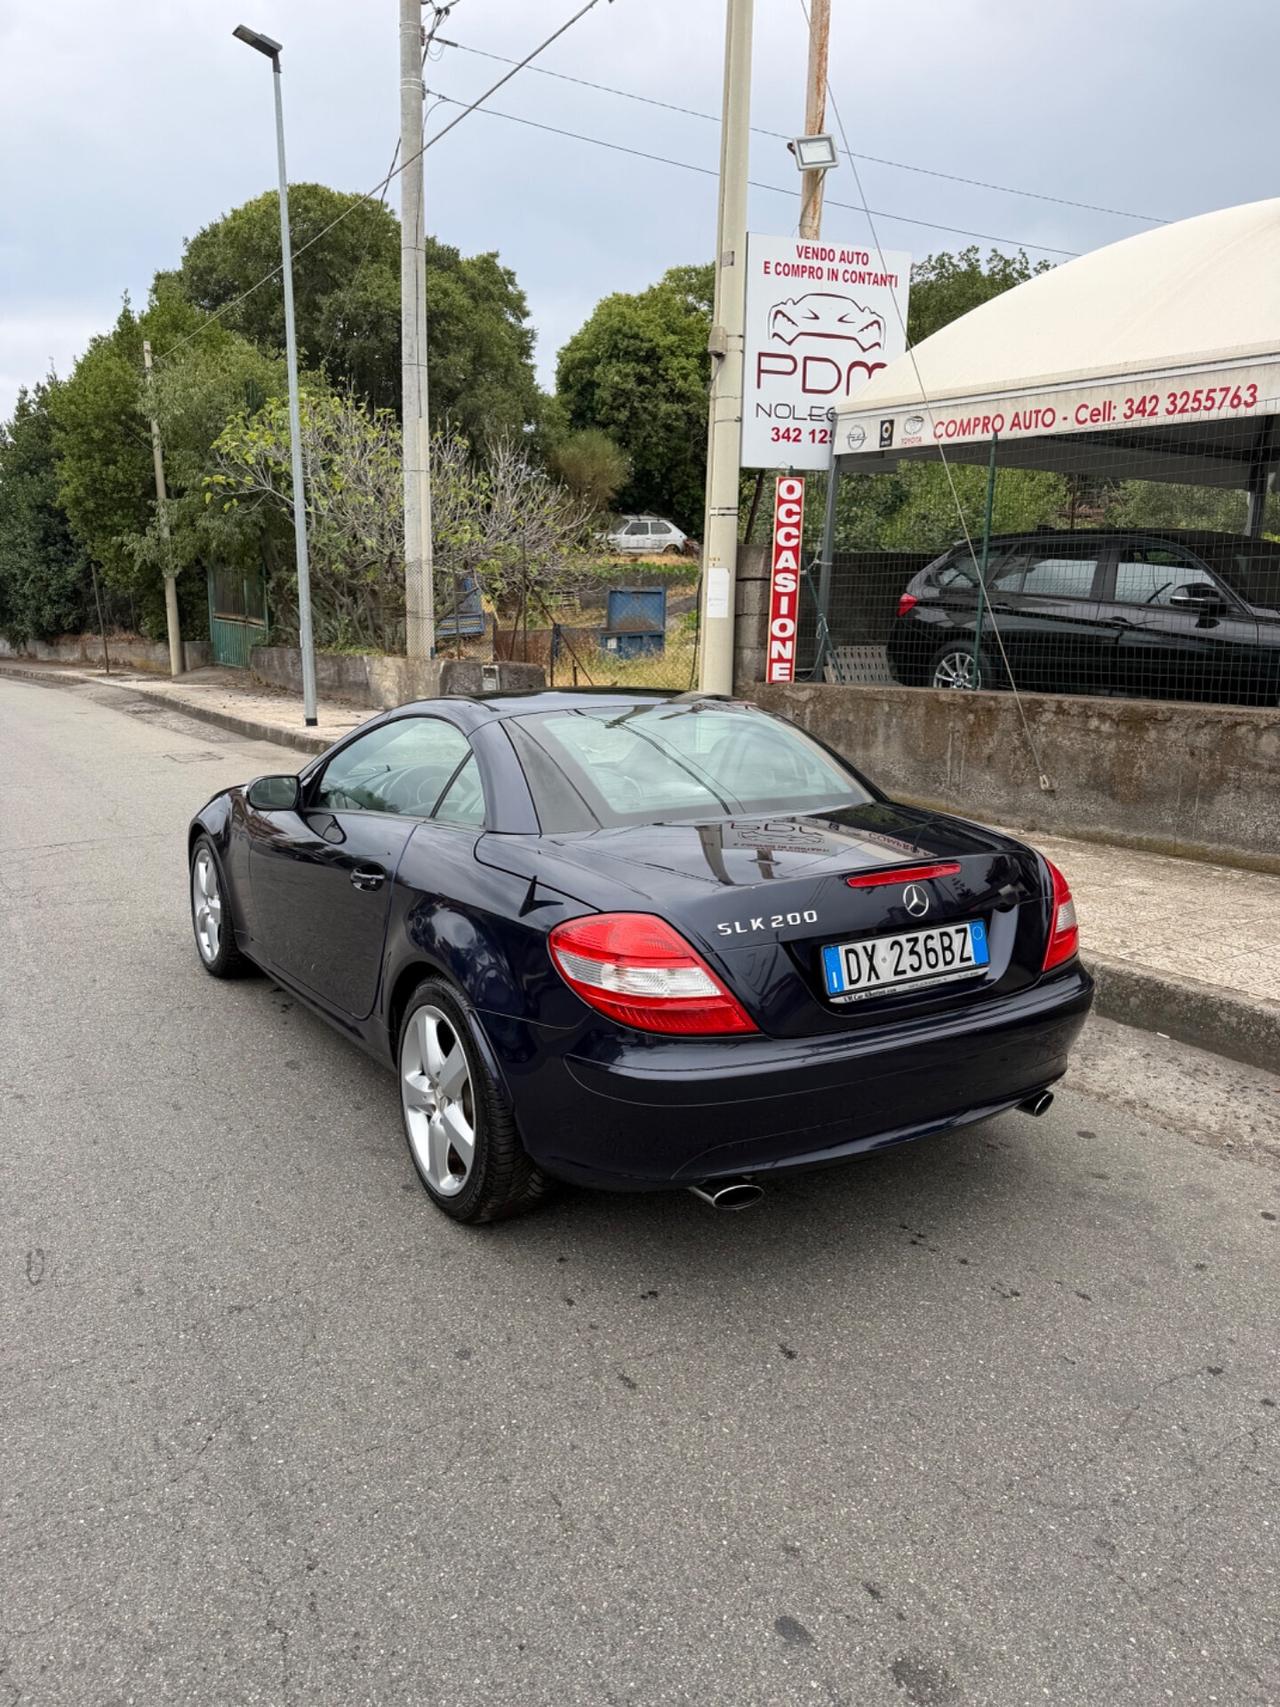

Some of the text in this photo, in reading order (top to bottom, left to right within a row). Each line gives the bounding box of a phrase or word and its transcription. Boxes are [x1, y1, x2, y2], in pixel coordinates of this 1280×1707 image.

[796, 244, 870, 266] VENDO AUTO
[763, 261, 899, 289] E COMPRO IN CONTANTI
[933, 413, 1005, 440] COMPRO
[1009, 407, 1056, 431] AUTO
[1074, 400, 1117, 426] Cell:
[1122, 394, 1160, 420] 342
[1164, 383, 1258, 416] 3255763
[770, 427, 833, 444] 342 12
[771, 479, 803, 681] OCCASIONE
[716, 910, 818, 936] SLK 200
[844, 943, 880, 985] DX
[890, 927, 972, 977] 236BZ
